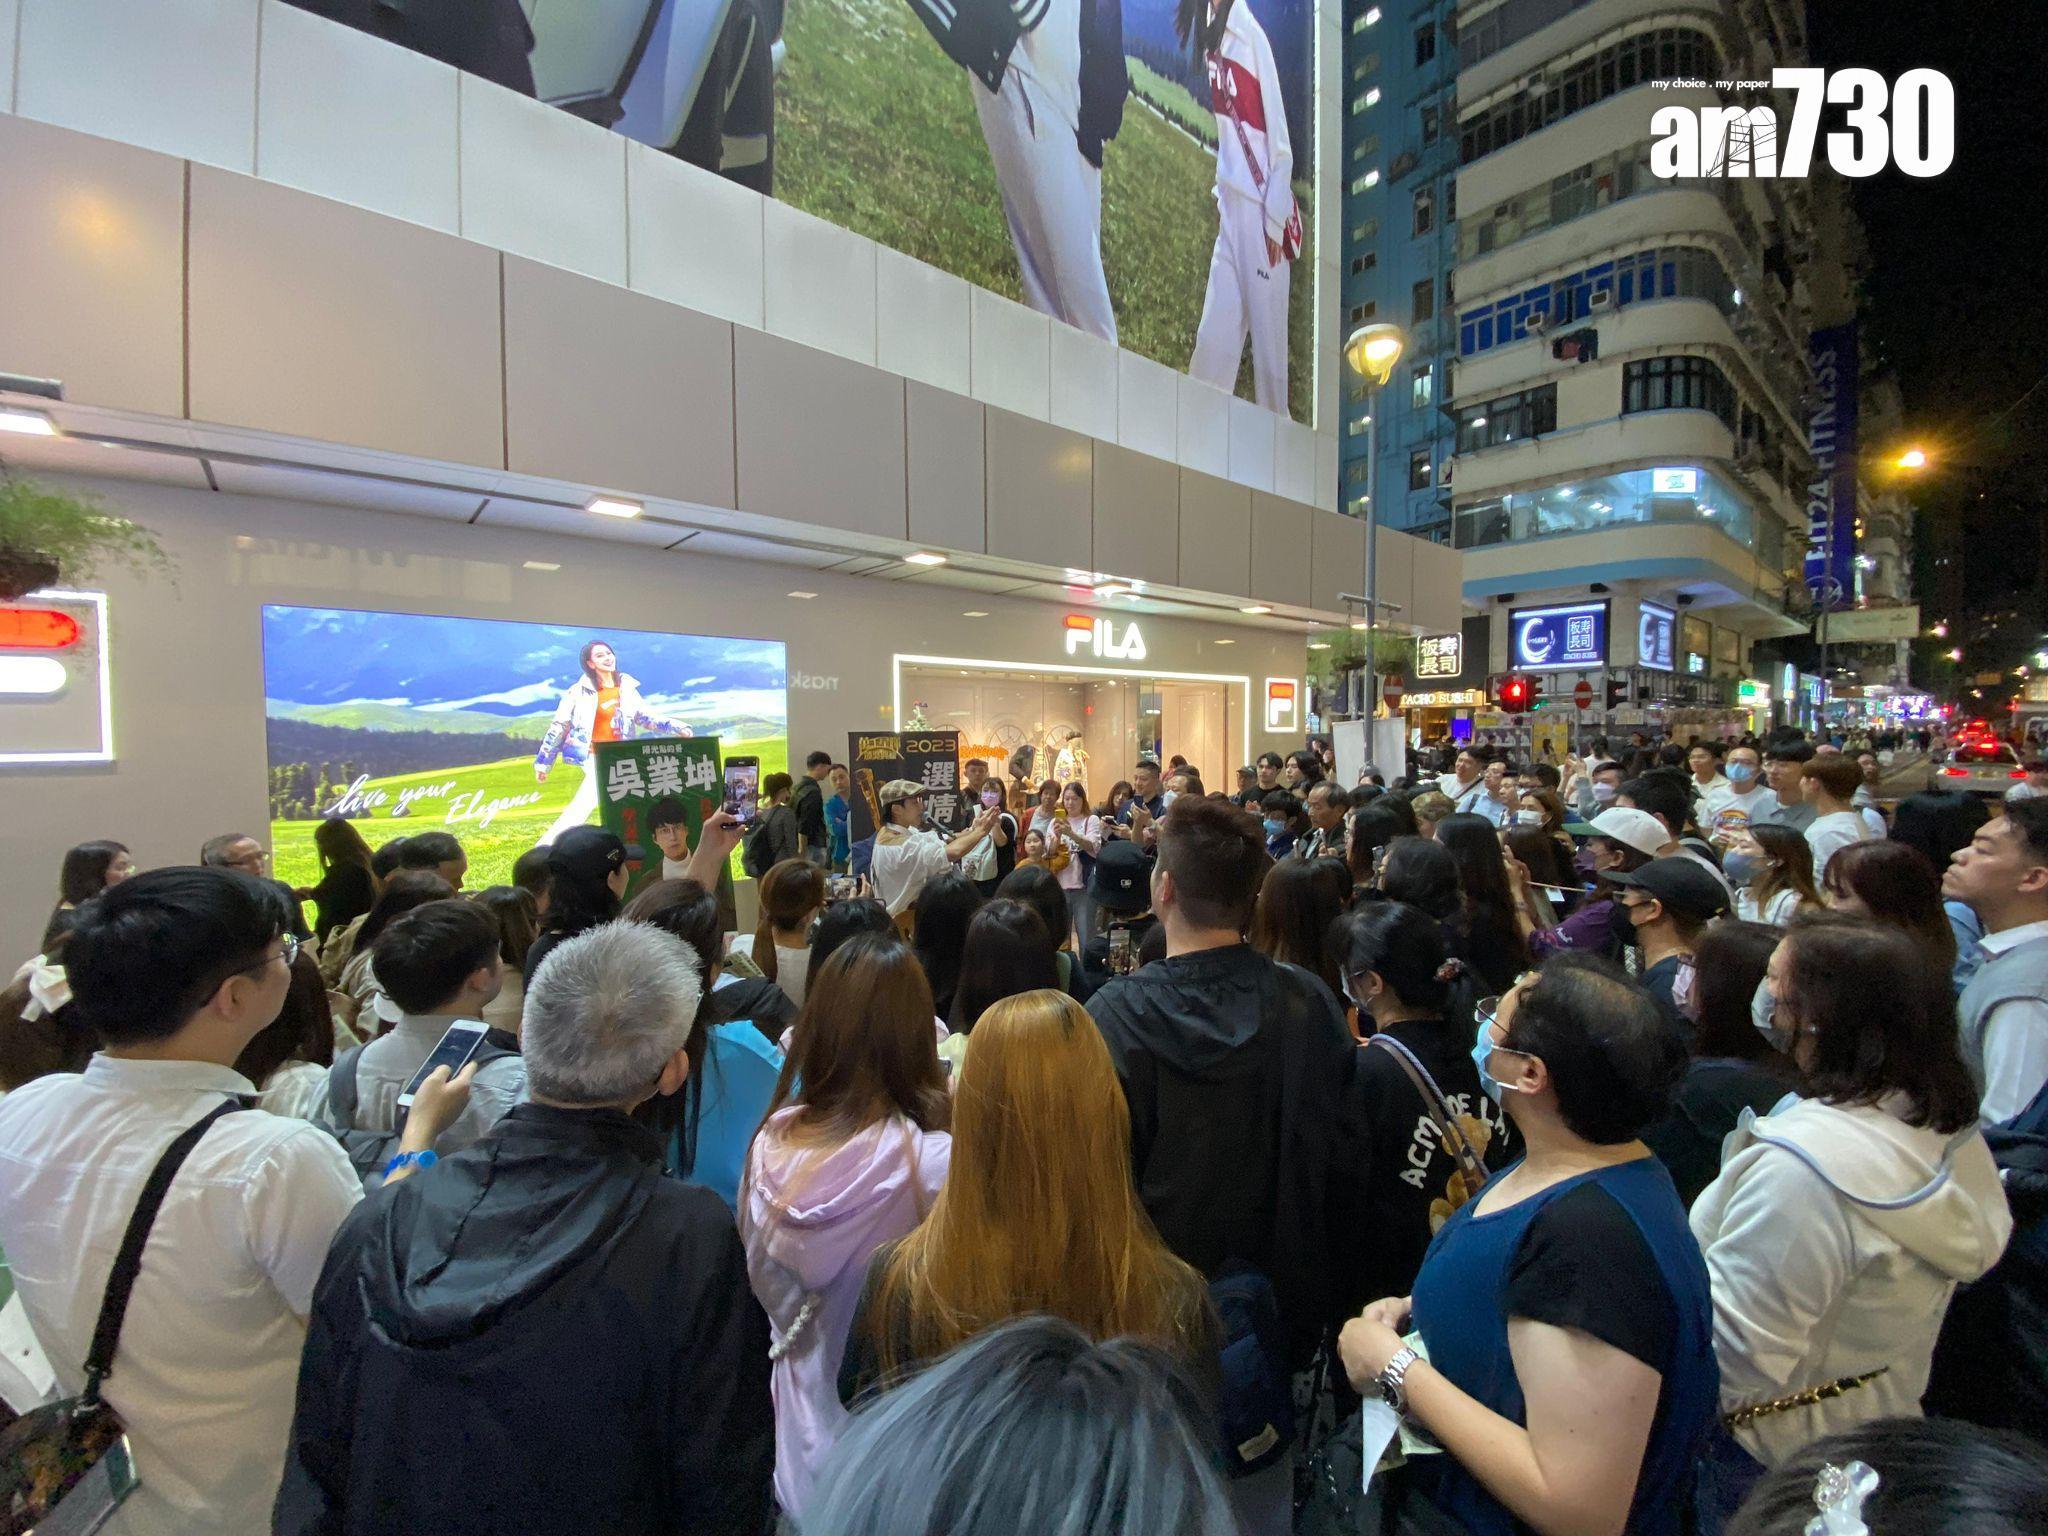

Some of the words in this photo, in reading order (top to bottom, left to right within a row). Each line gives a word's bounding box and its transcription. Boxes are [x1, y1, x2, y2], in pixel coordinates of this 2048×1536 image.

[1208, 60, 1238, 97] FIA
[1064, 614, 1147, 660] FILA
[1439, 692, 1473, 704] SUSHI
[906, 739, 956, 753] 2023
[606, 753, 717, 802] 吳業坤
[921, 761, 958, 824] 選情
[392, 780, 457, 817] your
[444, 788, 543, 829] Elegance
[1399, 1110, 1452, 1190] ACM
